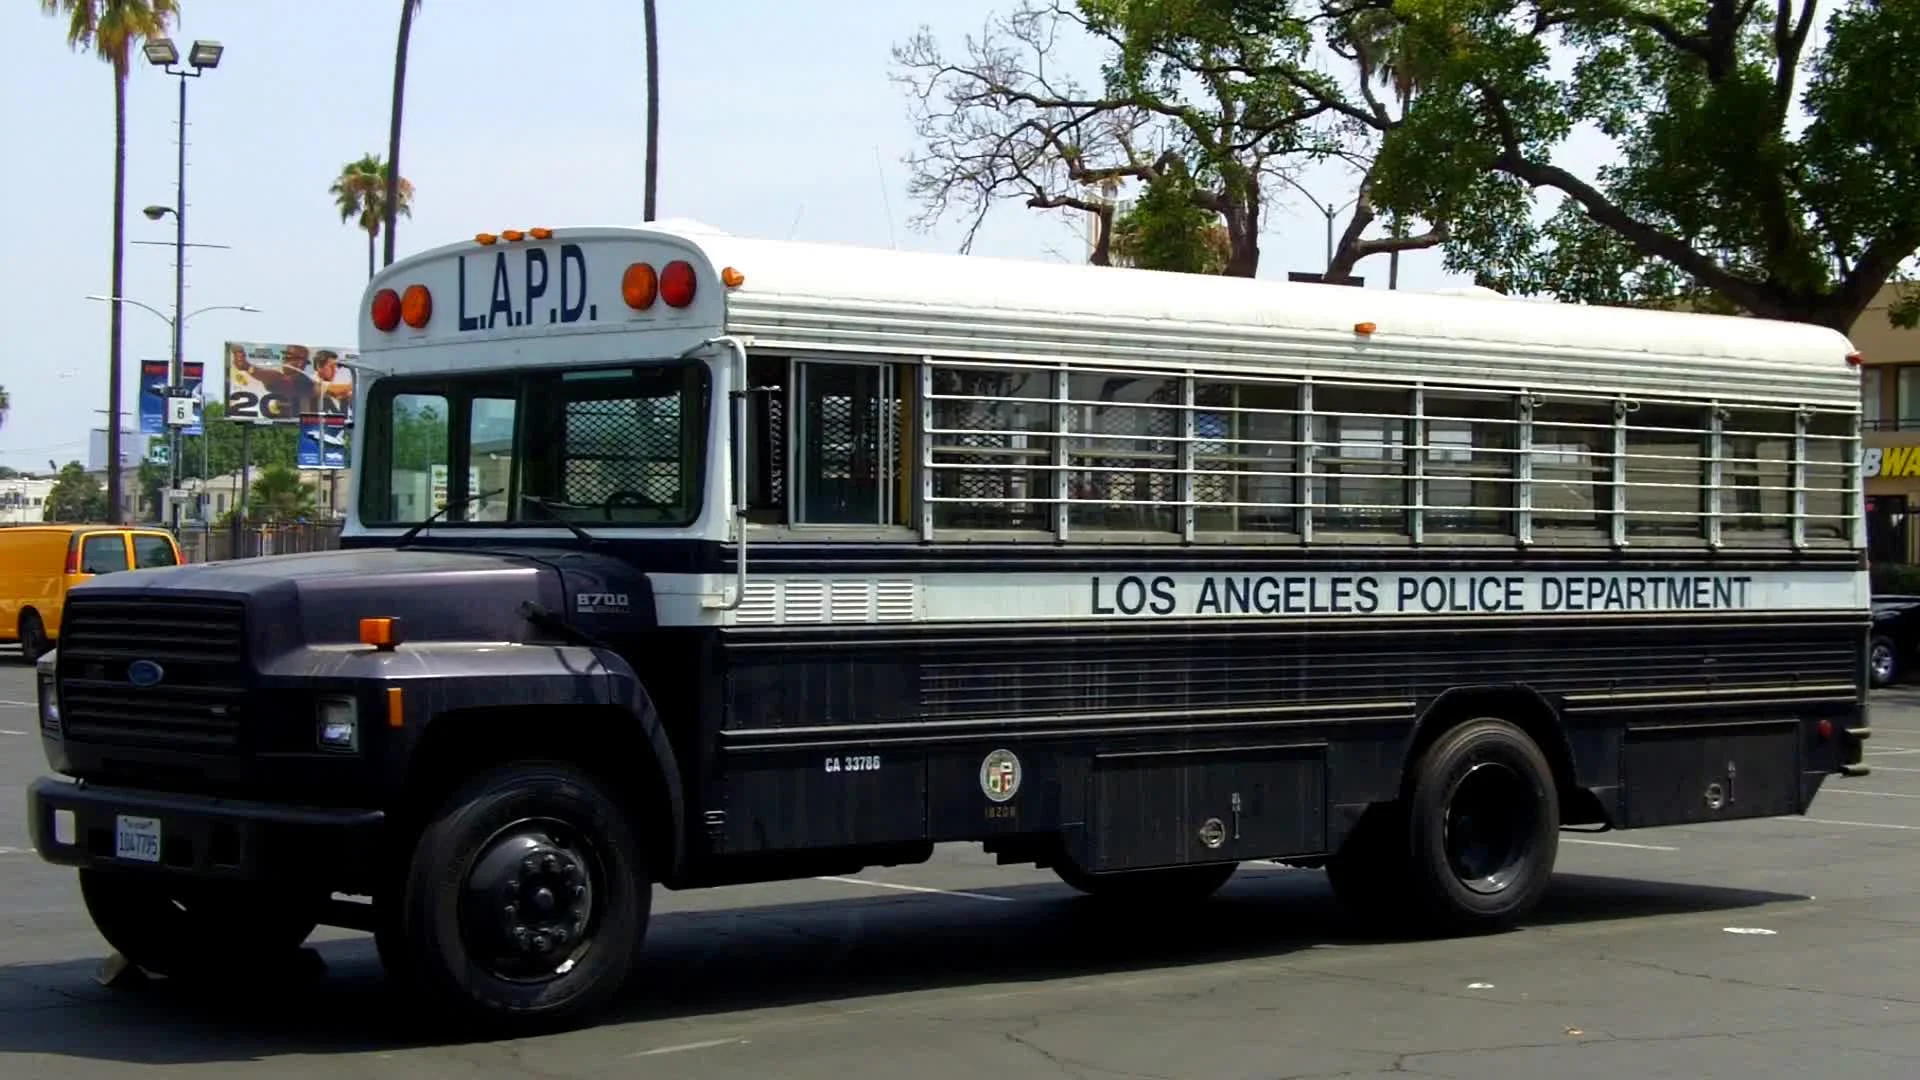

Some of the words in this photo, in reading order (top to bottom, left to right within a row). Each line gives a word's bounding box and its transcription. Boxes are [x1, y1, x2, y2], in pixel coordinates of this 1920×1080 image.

[459, 244, 597, 331] L.A.P.D.
[177, 407, 185, 420] 6
[1862, 447, 1920, 477] BWA
[1091, 575, 1176, 615] LOS
[1195, 575, 1379, 615] ANGELES
[1397, 575, 1525, 613] POLICE
[1541, 575, 1752, 611] DEPARTMENT
[825, 757, 841, 773] CA
[844, 755, 881, 772] 33786
